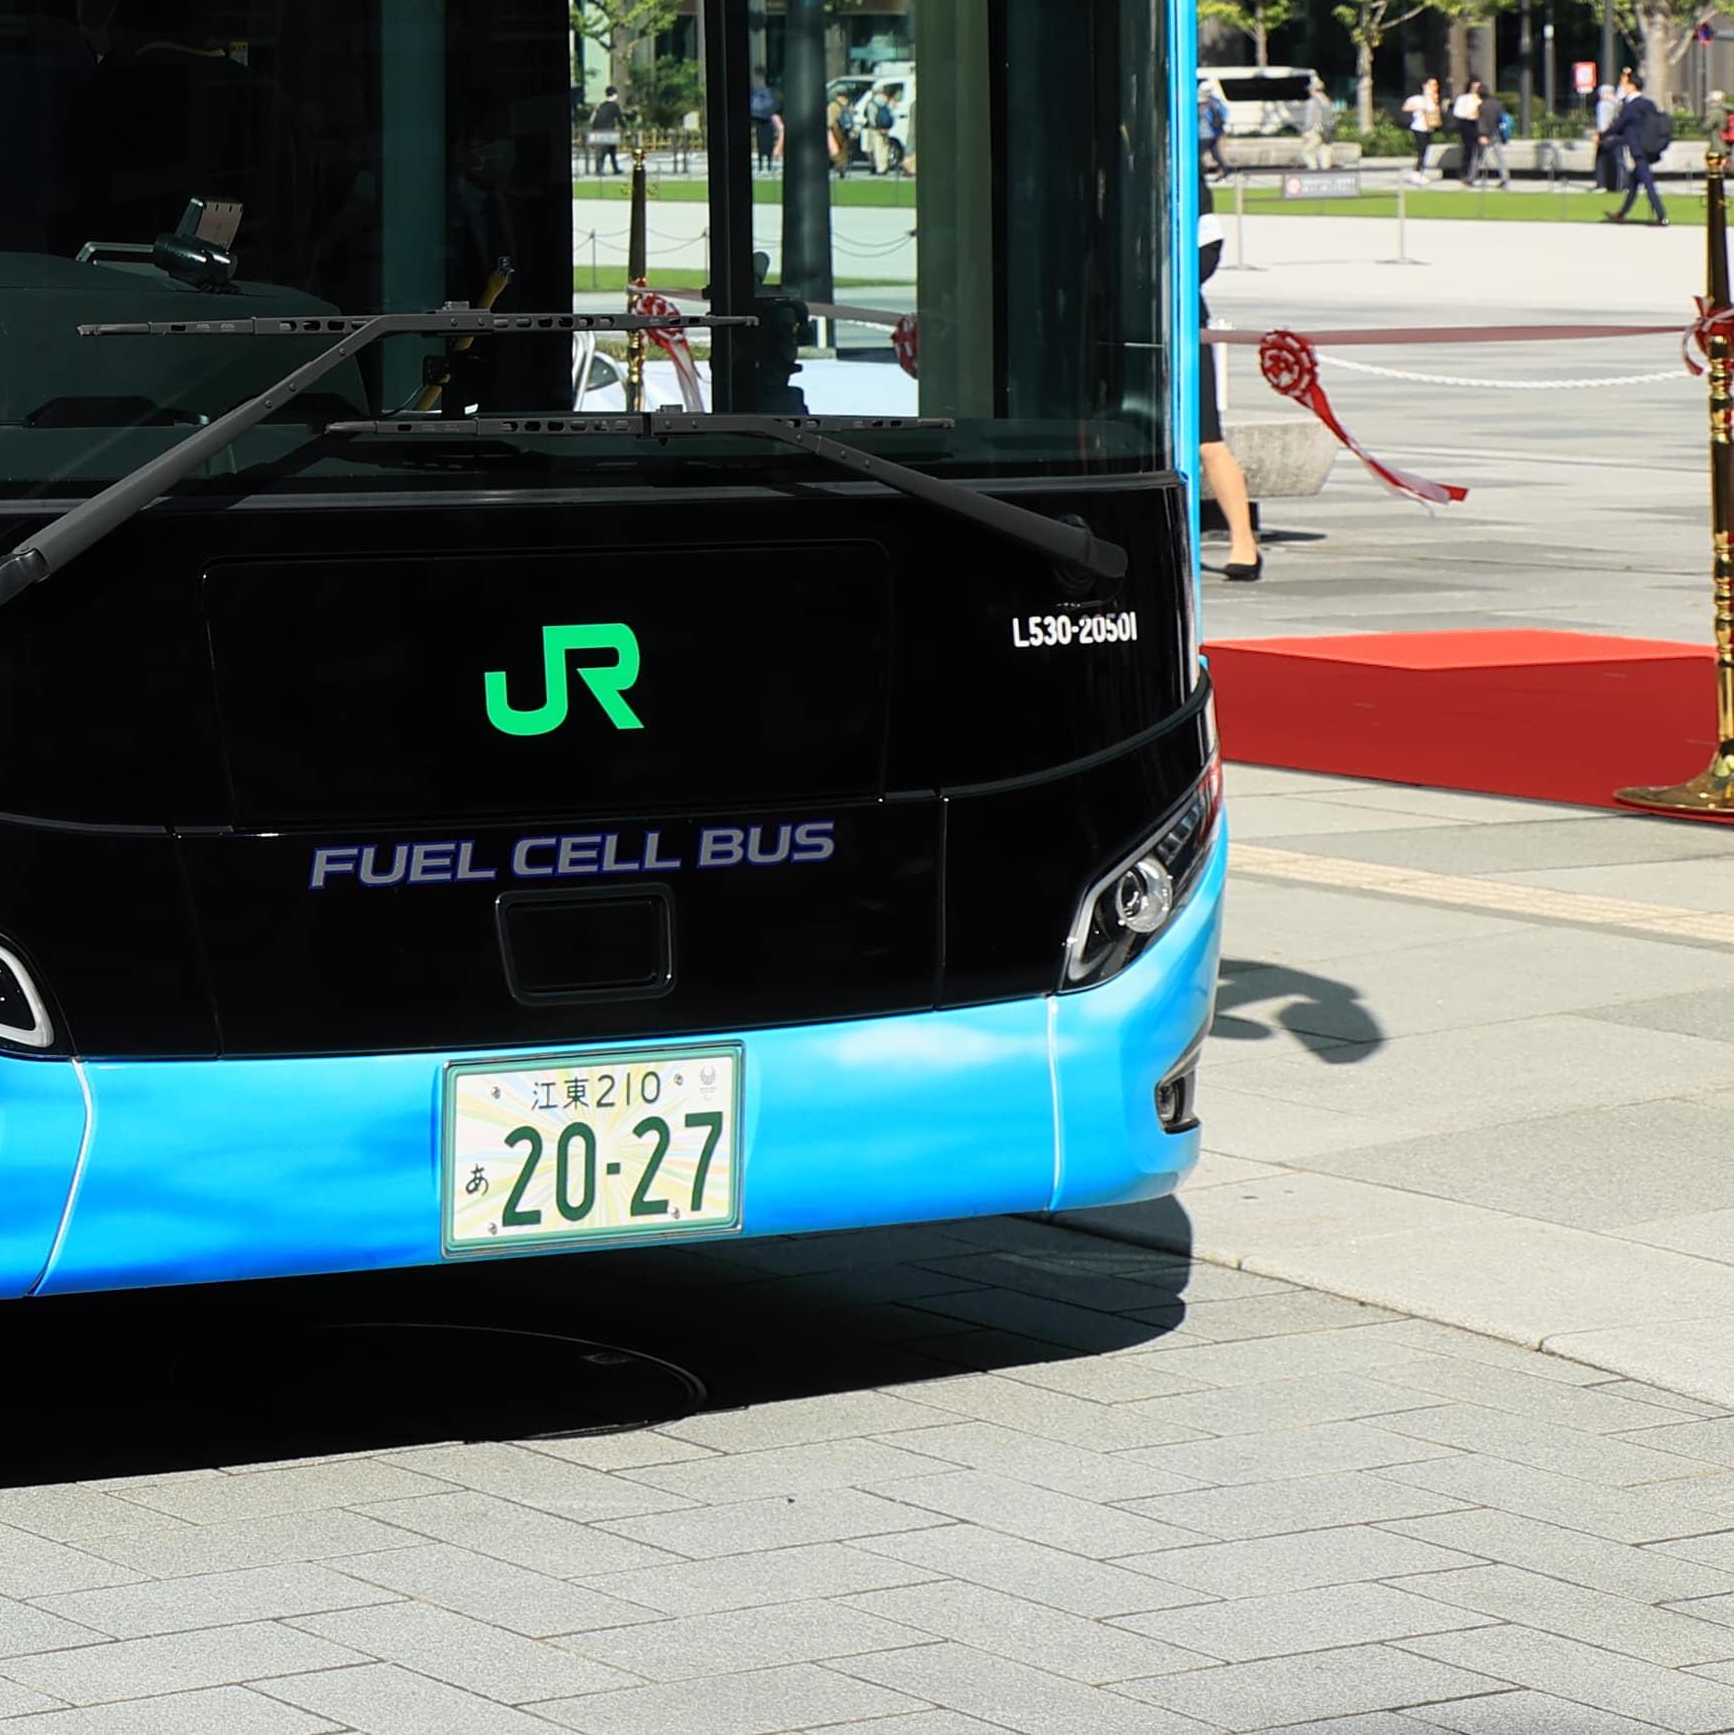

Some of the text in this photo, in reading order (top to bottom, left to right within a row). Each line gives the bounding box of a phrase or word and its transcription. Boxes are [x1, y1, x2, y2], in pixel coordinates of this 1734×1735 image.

[1012, 611, 1138, 648] L530-20501
[484, 622, 645, 736] JR
[309, 821, 836, 890] FUEL CELL BUS
[465, 1110, 724, 1228] あ 20-27
